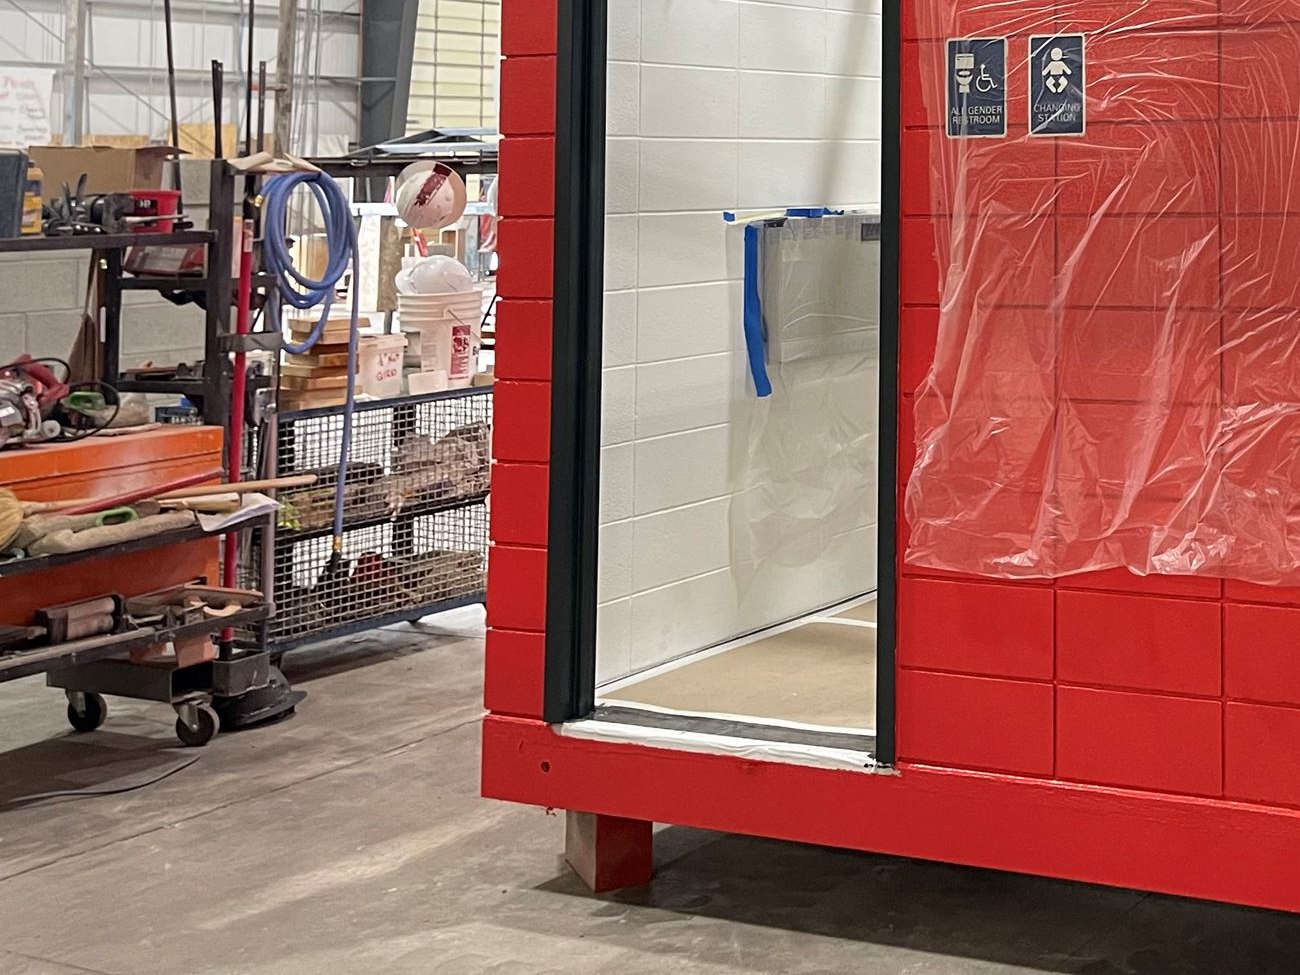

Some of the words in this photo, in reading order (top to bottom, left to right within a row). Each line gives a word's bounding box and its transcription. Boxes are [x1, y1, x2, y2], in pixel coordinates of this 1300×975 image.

[967, 105, 1003, 115] GENDER
[1033, 103, 1081, 113] CHANGING
[1037, 113, 1077, 123] STATION
